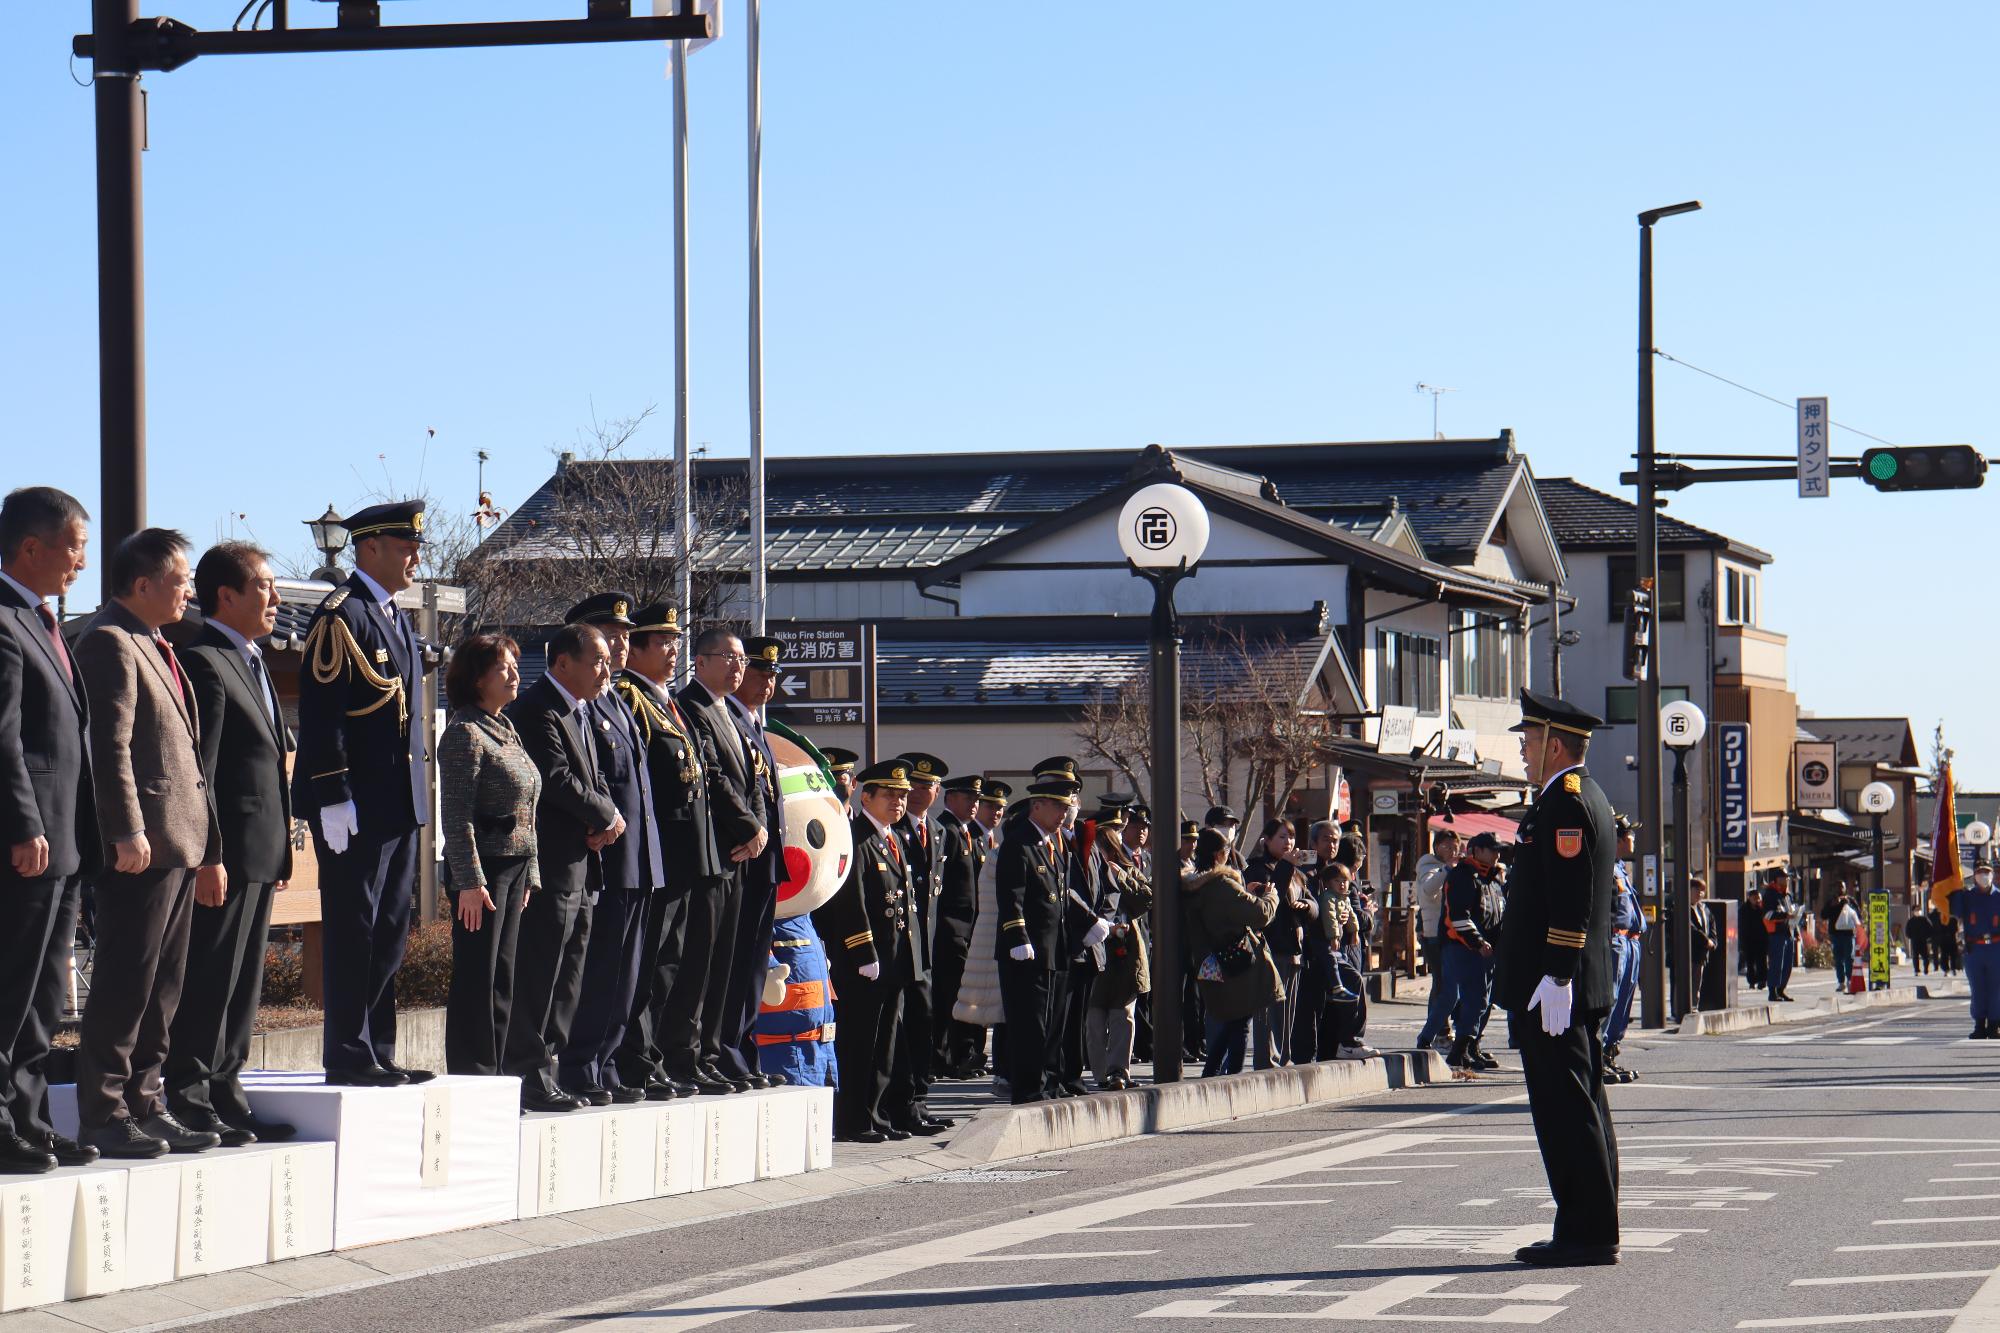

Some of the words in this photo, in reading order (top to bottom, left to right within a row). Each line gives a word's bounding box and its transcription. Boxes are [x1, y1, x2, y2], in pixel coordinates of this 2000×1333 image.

[1804, 404, 1822, 492] 押ボタン式
[774, 631, 797, 640] Nikko
[799, 631, 814, 639] Fire
[816, 631, 845, 639] Station
[780, 641, 855, 659] 光消防署
[815, 715, 841, 723] 日光市
[1725, 730, 1746, 839] クリーニング
